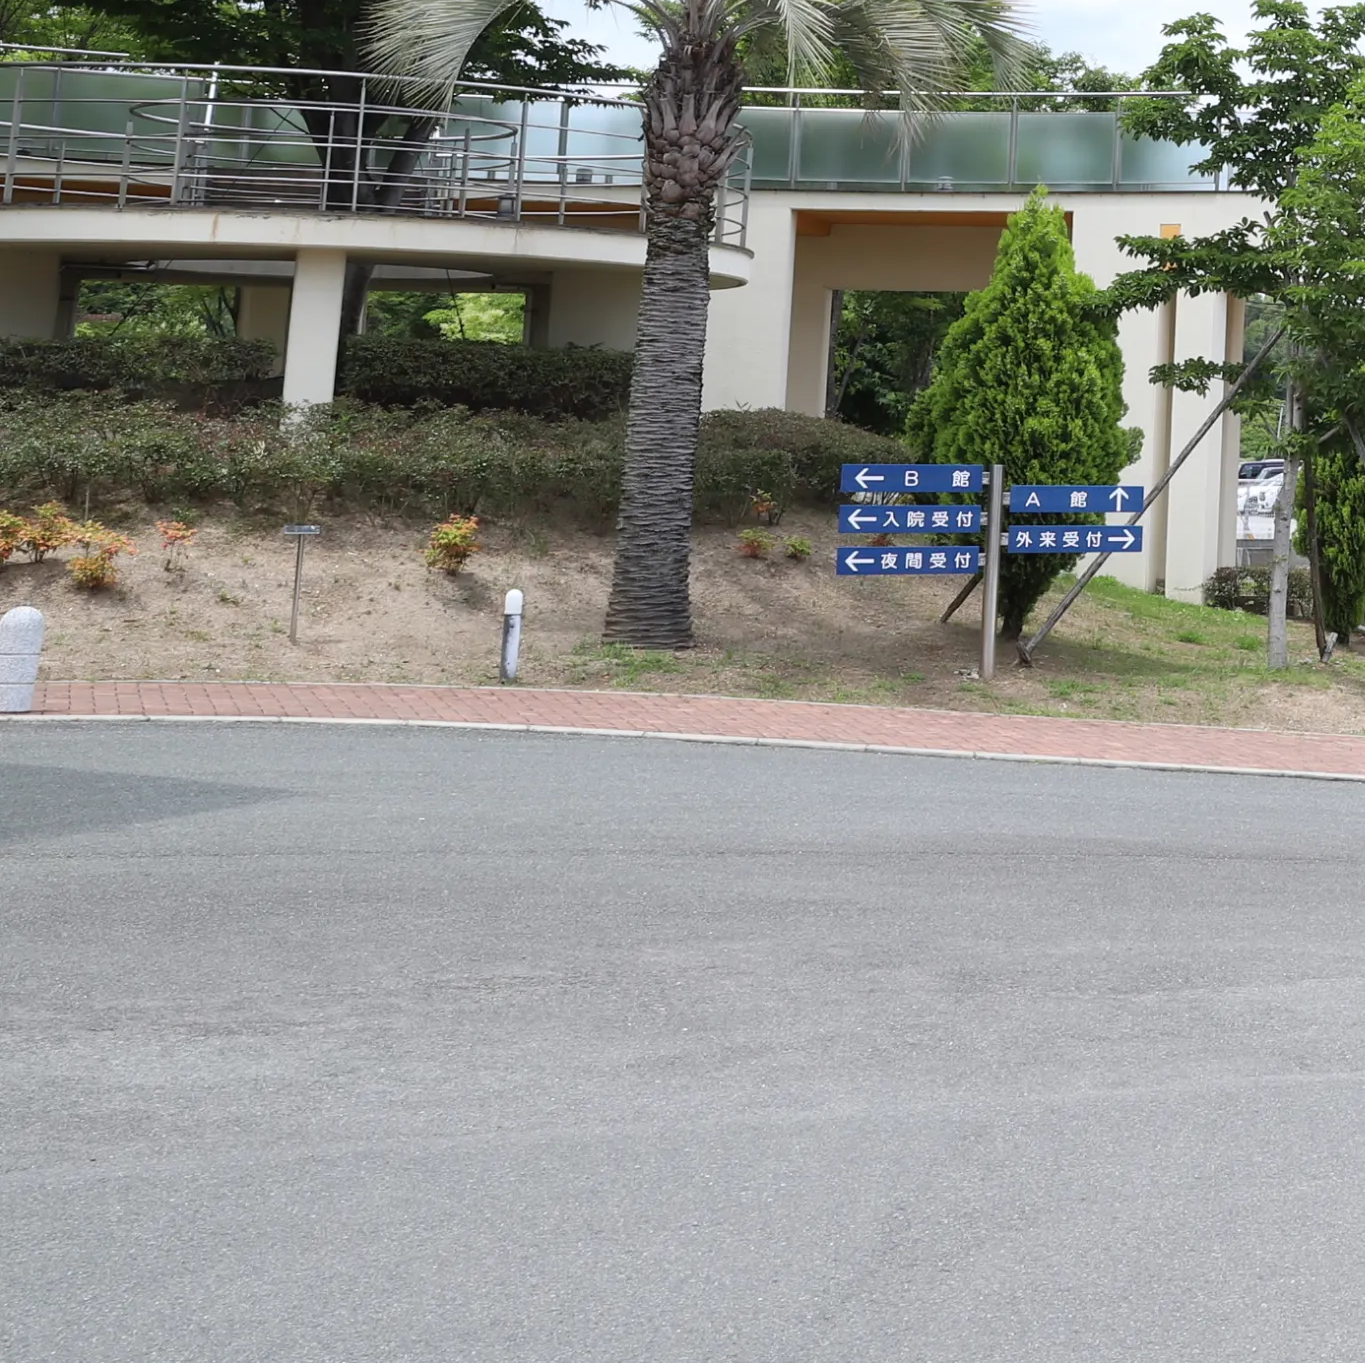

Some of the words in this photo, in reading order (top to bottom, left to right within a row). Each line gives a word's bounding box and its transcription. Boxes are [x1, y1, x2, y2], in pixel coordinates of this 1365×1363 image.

[883, 511, 973, 527] 入院受付
[1016, 532, 1102, 547] 外来受付
[881, 553, 971, 569] 夜間受付
